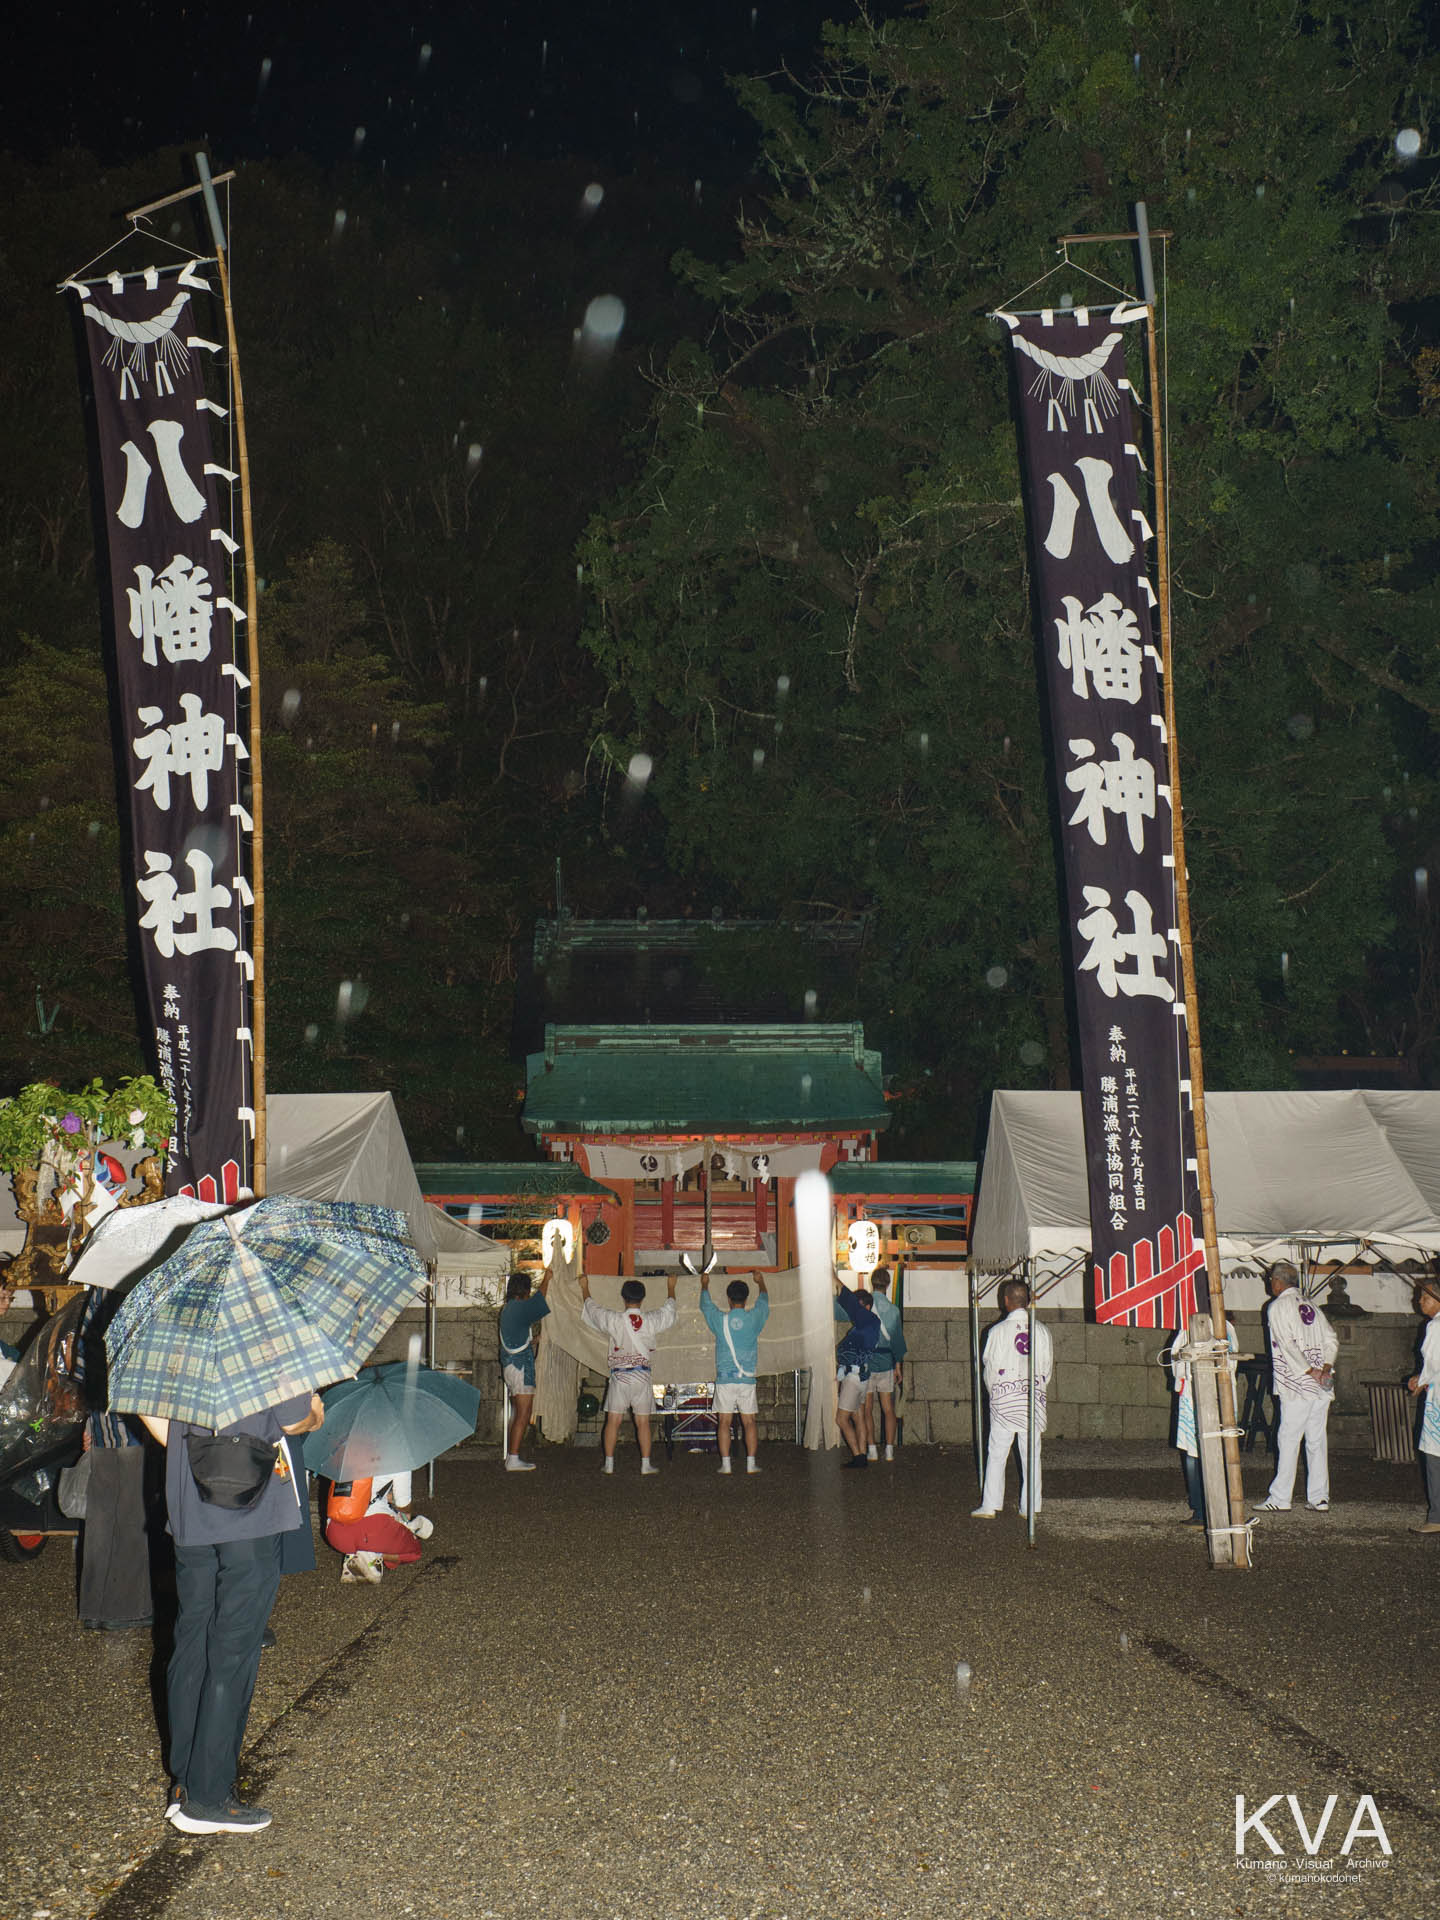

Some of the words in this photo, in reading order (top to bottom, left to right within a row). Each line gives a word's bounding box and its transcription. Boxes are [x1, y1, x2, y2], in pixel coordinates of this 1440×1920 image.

[116, 419, 237, 958] 八幡神社
[1043, 456, 1175, 1003] 八幡神社
[163, 984, 181, 1020] 奉納
[1108, 1024, 1127, 1063] 奉納
[1100, 1076, 1128, 1231] 勝浦漁業協同組合
[1124, 1068, 1146, 1211] 平成二十八年九月吉日
